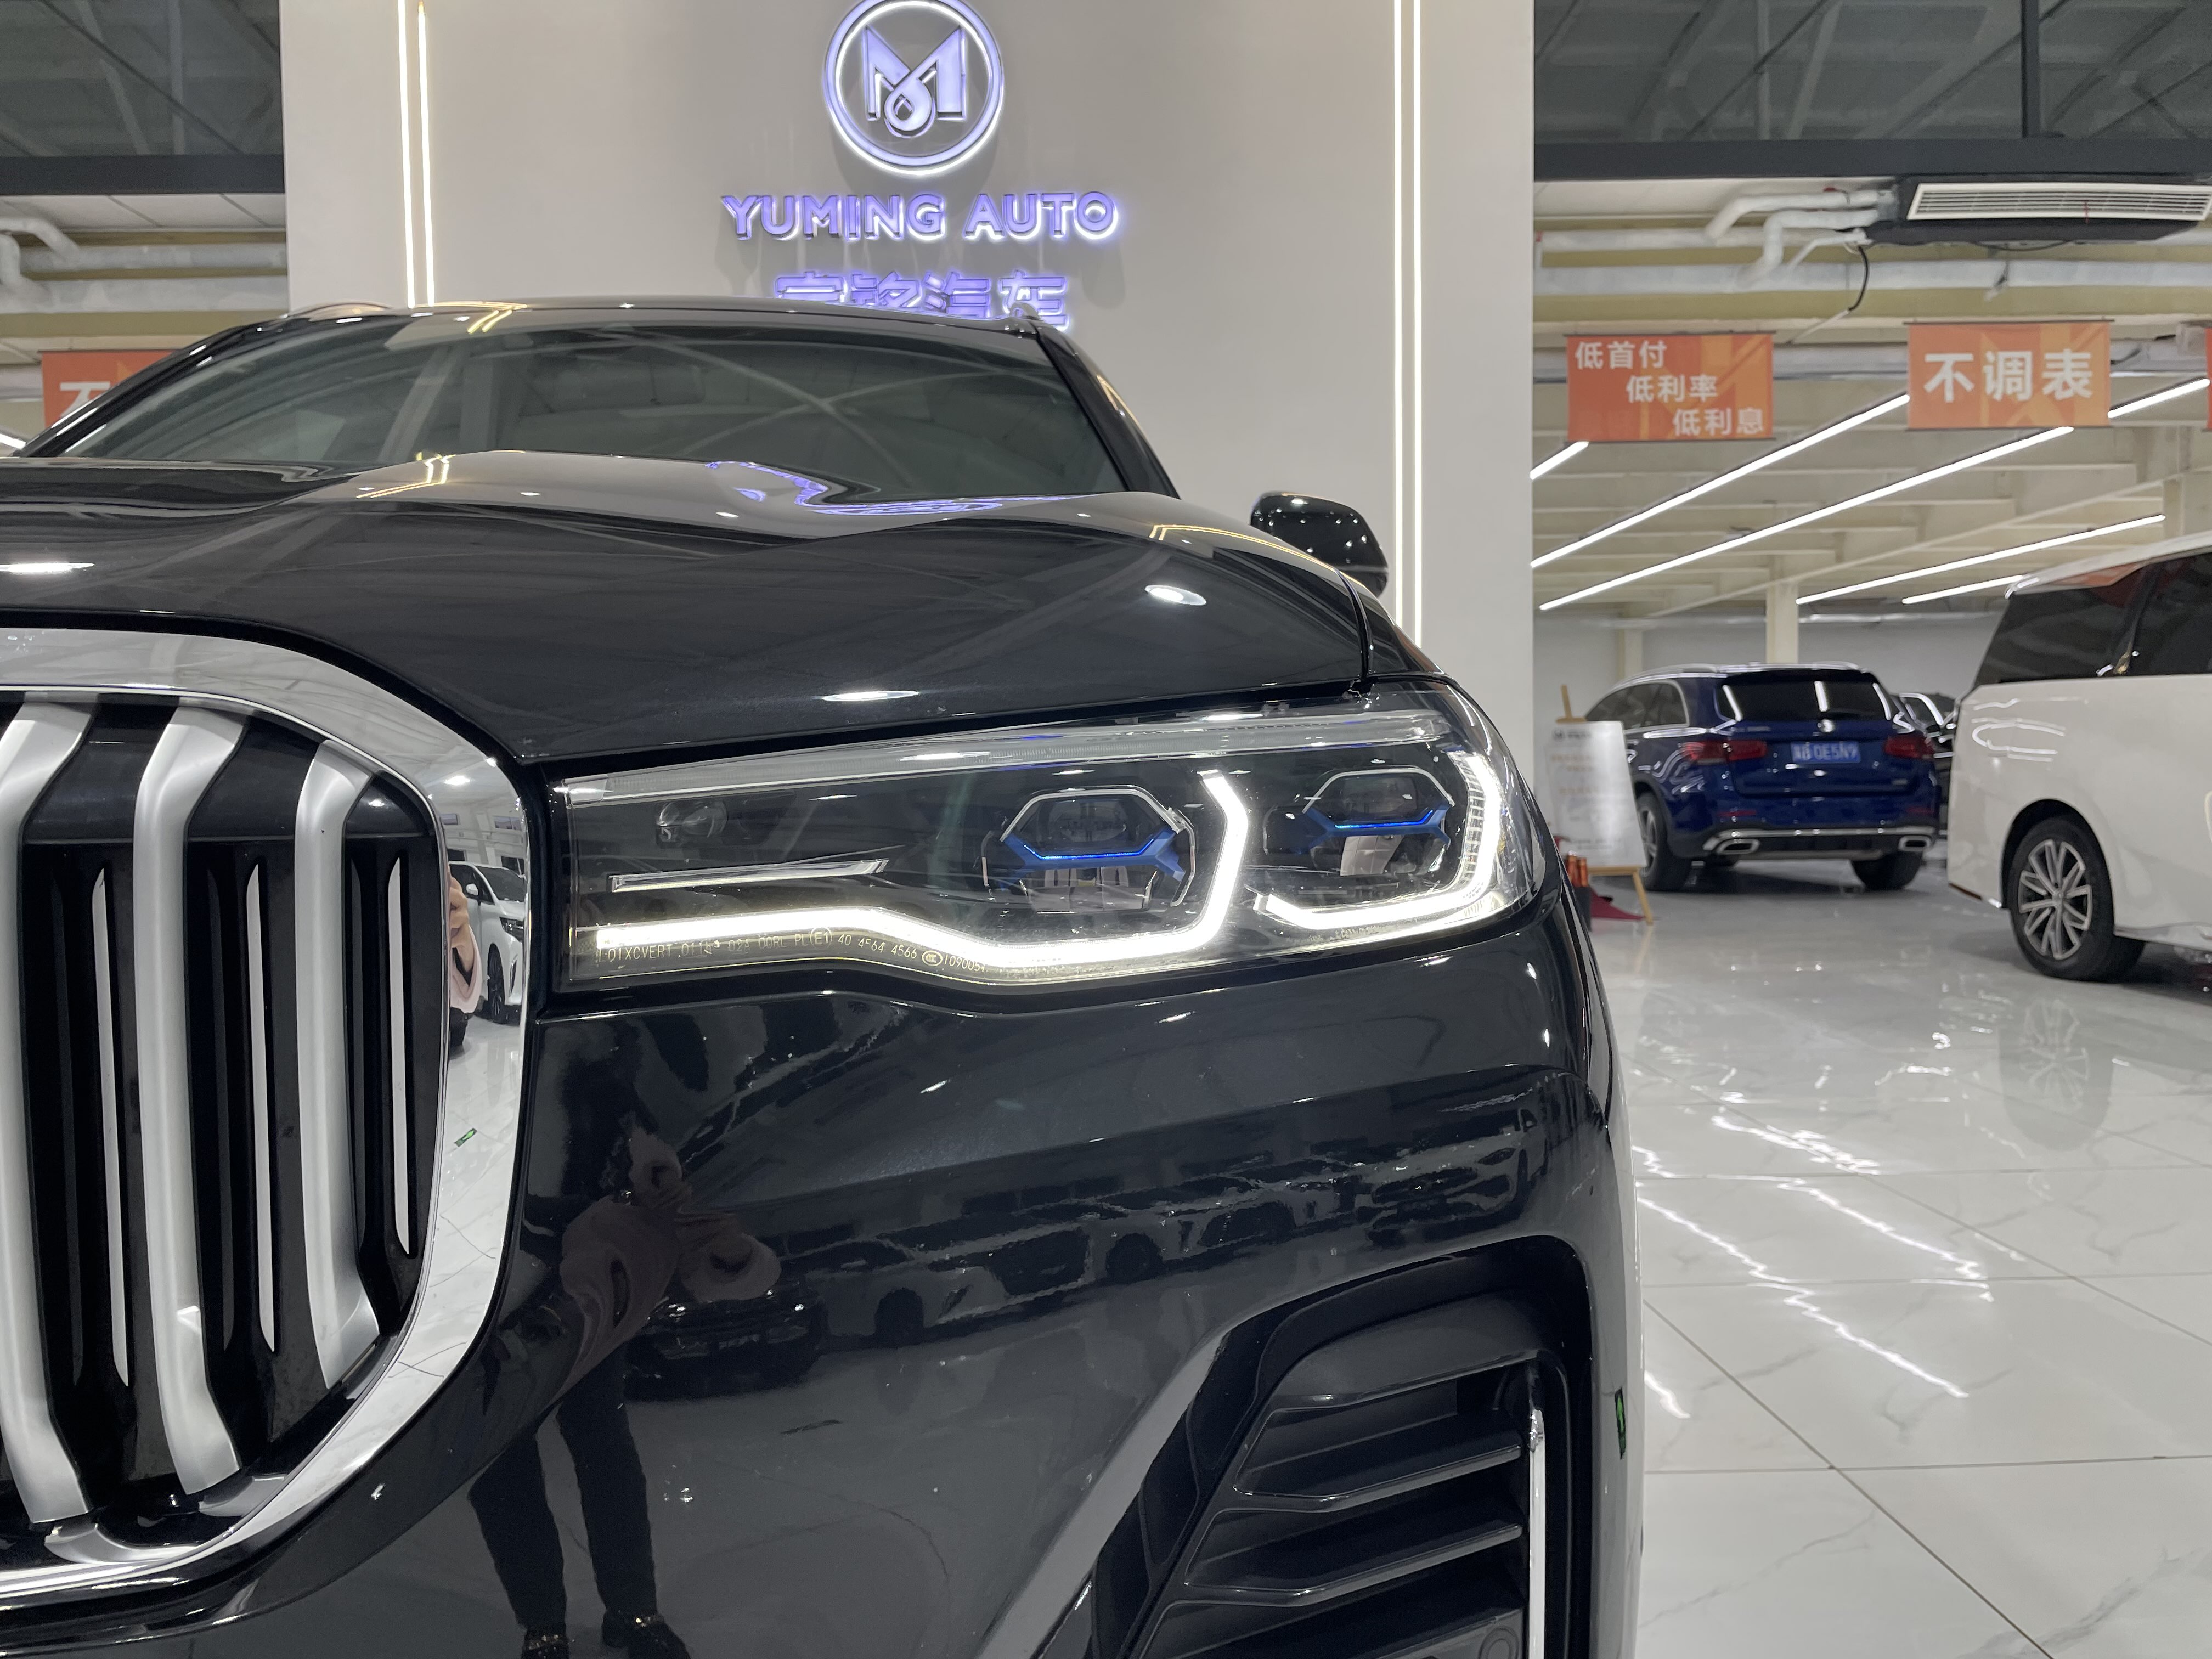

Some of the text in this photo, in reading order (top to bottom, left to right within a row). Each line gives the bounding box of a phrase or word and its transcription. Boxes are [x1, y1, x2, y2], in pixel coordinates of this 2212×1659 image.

[723, 192, 1118, 240] YUMING AUTO
[1575, 340, 1667, 369] 低首付
[1626, 374, 1718, 403] 低利率
[1924, 348, 2093, 403] 不调表
[1672, 408, 1764, 437] 低利息
